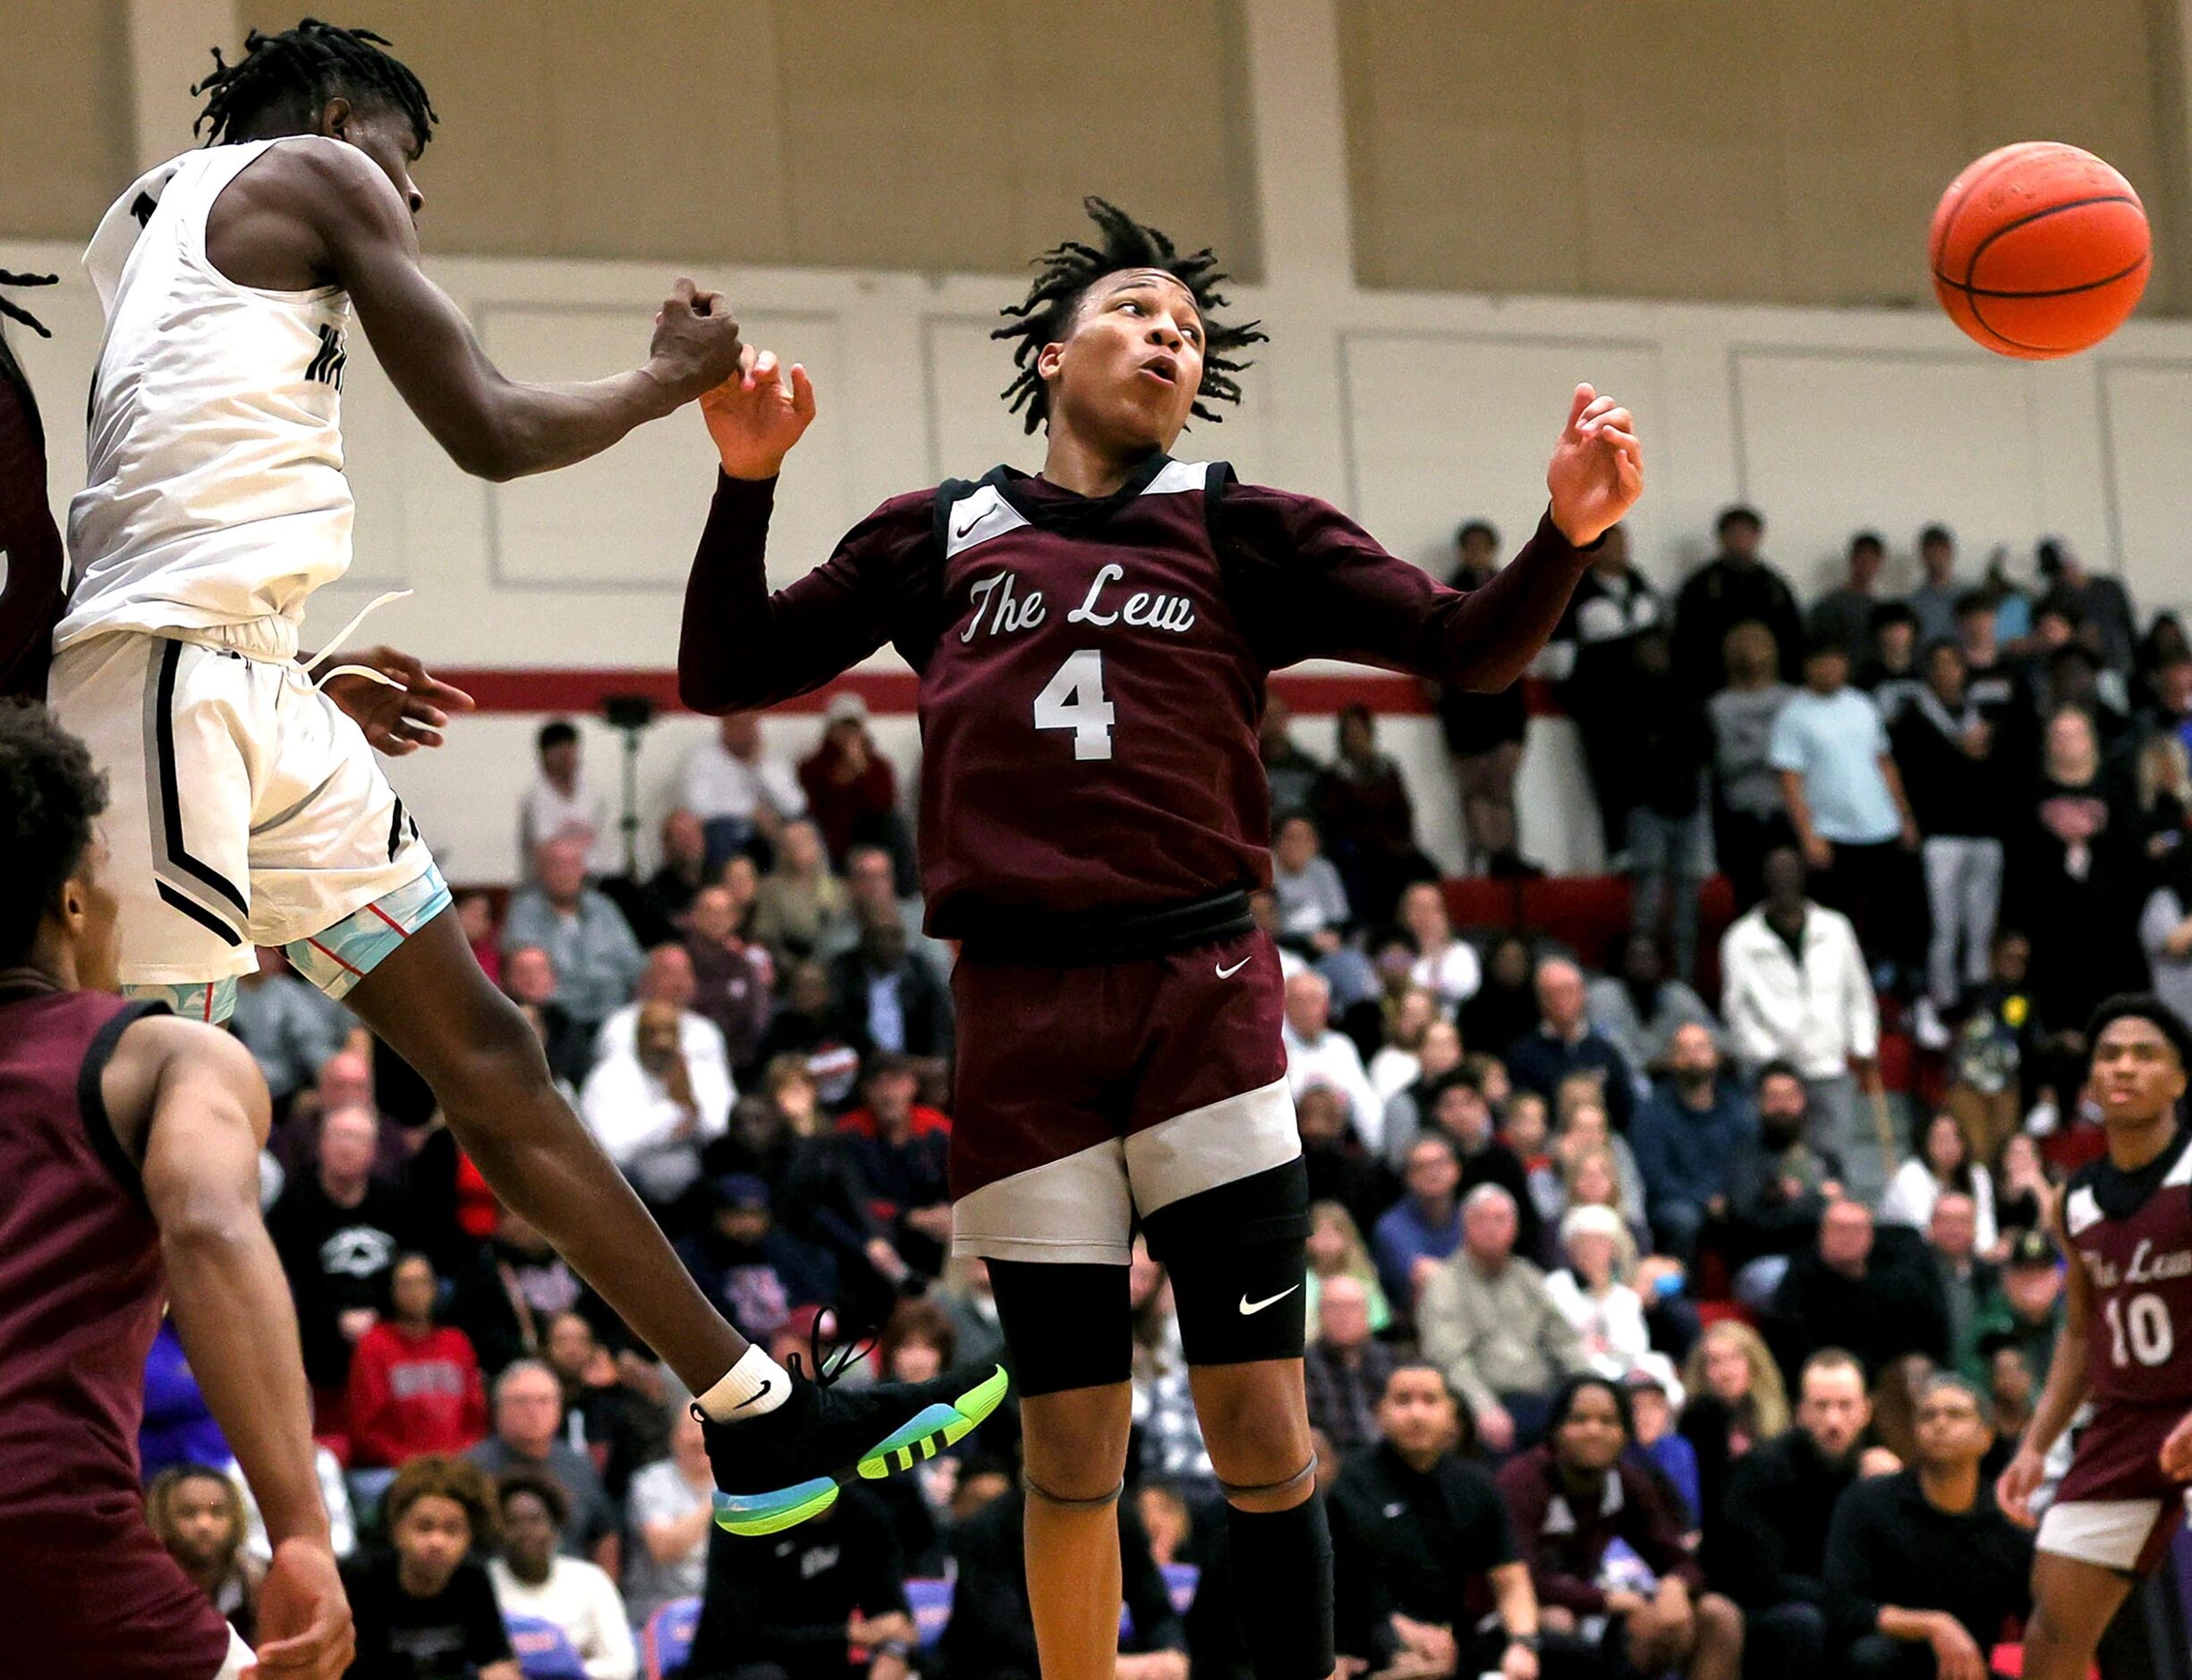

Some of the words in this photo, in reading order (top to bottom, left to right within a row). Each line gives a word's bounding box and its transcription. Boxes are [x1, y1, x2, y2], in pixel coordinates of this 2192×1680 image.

[960, 570, 1046, 643] The
[1067, 564, 1195, 632] Lew
[1033, 649, 1115, 760] 4
[2105, 1294, 2174, 1369] 10
